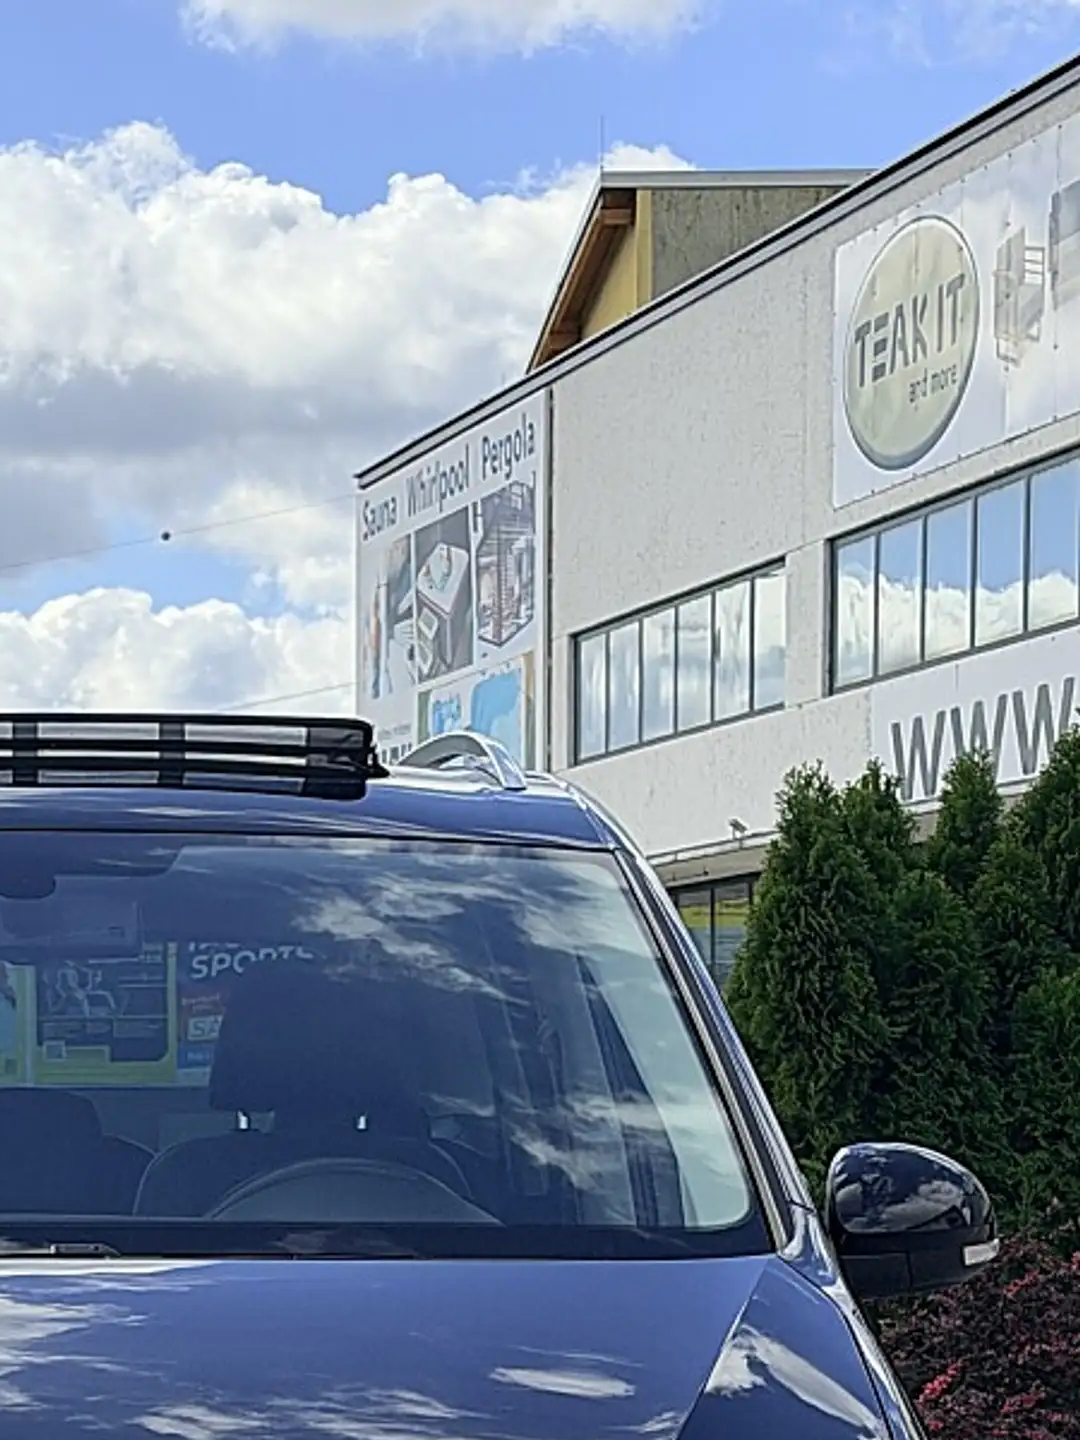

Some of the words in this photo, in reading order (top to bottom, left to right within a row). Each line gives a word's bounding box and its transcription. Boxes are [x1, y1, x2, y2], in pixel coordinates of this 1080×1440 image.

[854, 293, 928, 389] TEAK
[937, 273, 966, 354] IT
[908, 367, 929, 404] and
[930, 363, 958, 391] more
[362, 495, 398, 542] Sauna
[406, 443, 470, 518] Whirlpool
[481, 418, 536, 482] Pergola
